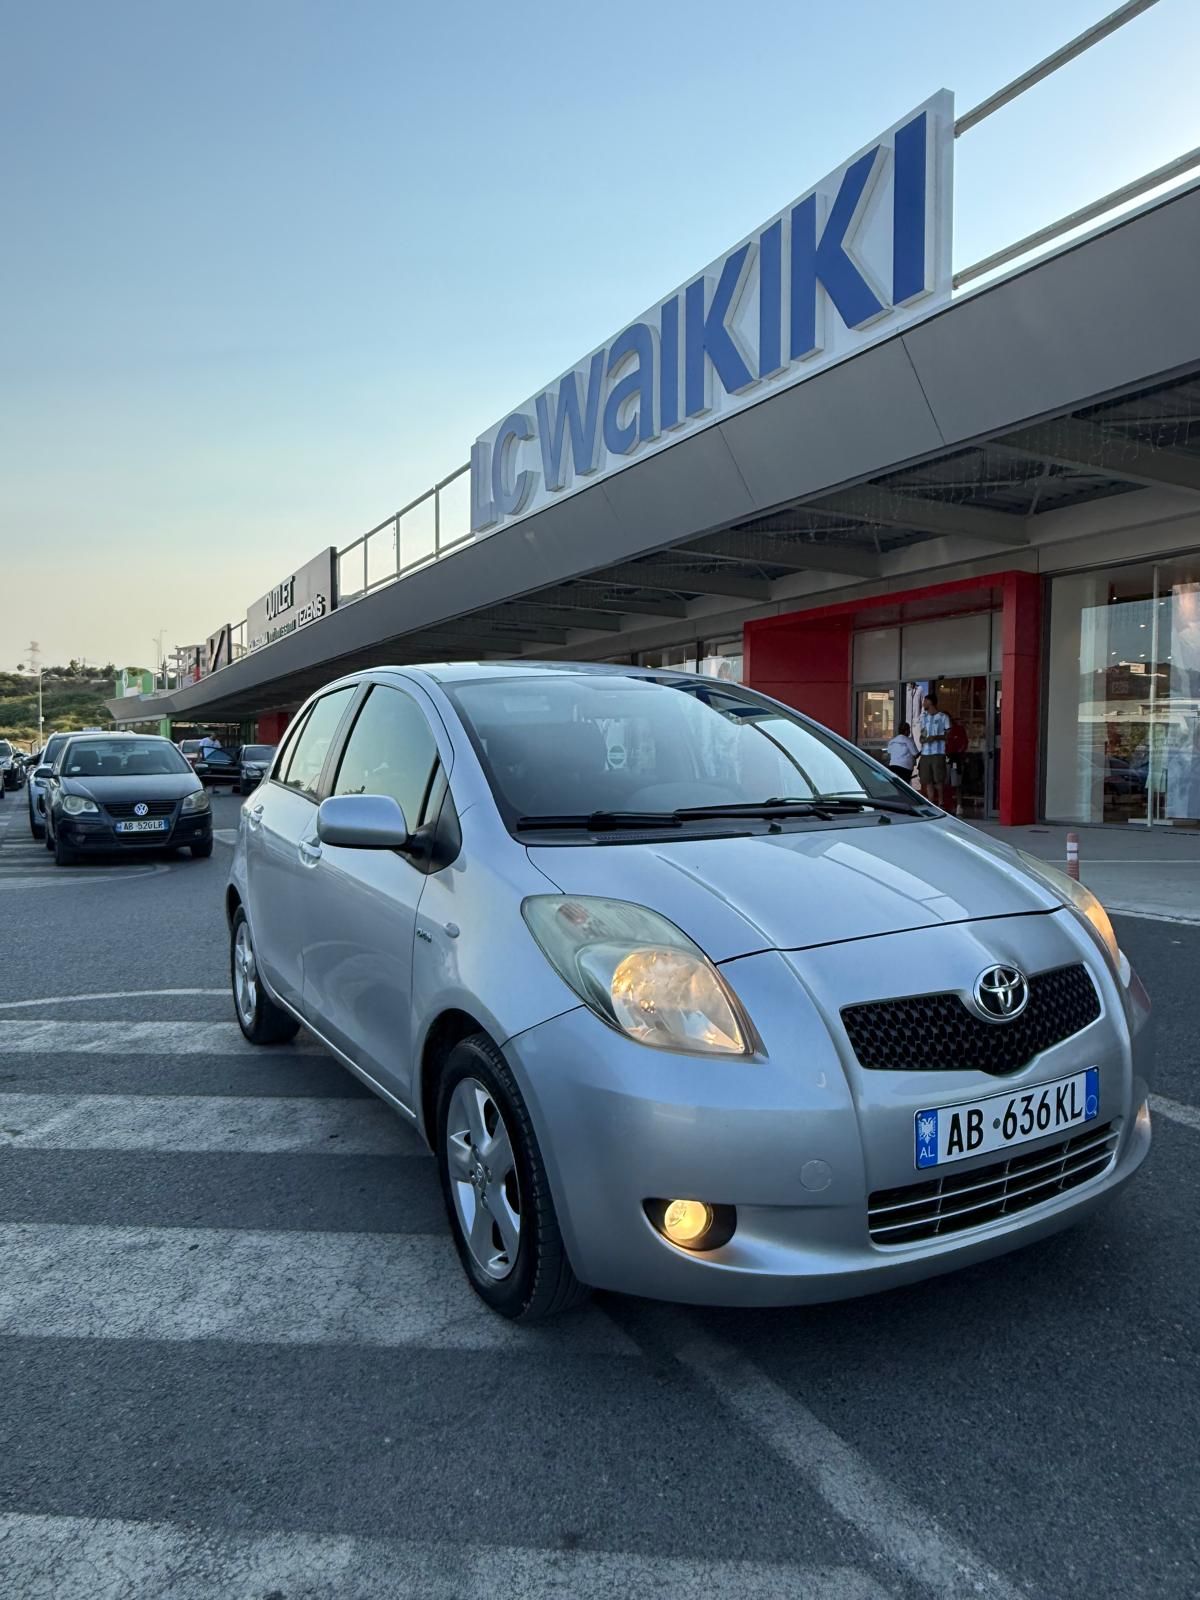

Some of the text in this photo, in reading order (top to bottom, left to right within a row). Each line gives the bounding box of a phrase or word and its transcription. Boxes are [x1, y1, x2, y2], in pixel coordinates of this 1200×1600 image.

[470, 412, 533, 533] LC
[919, 1146, 936, 1160] AL
[946, 1108, 984, 1156] AB
